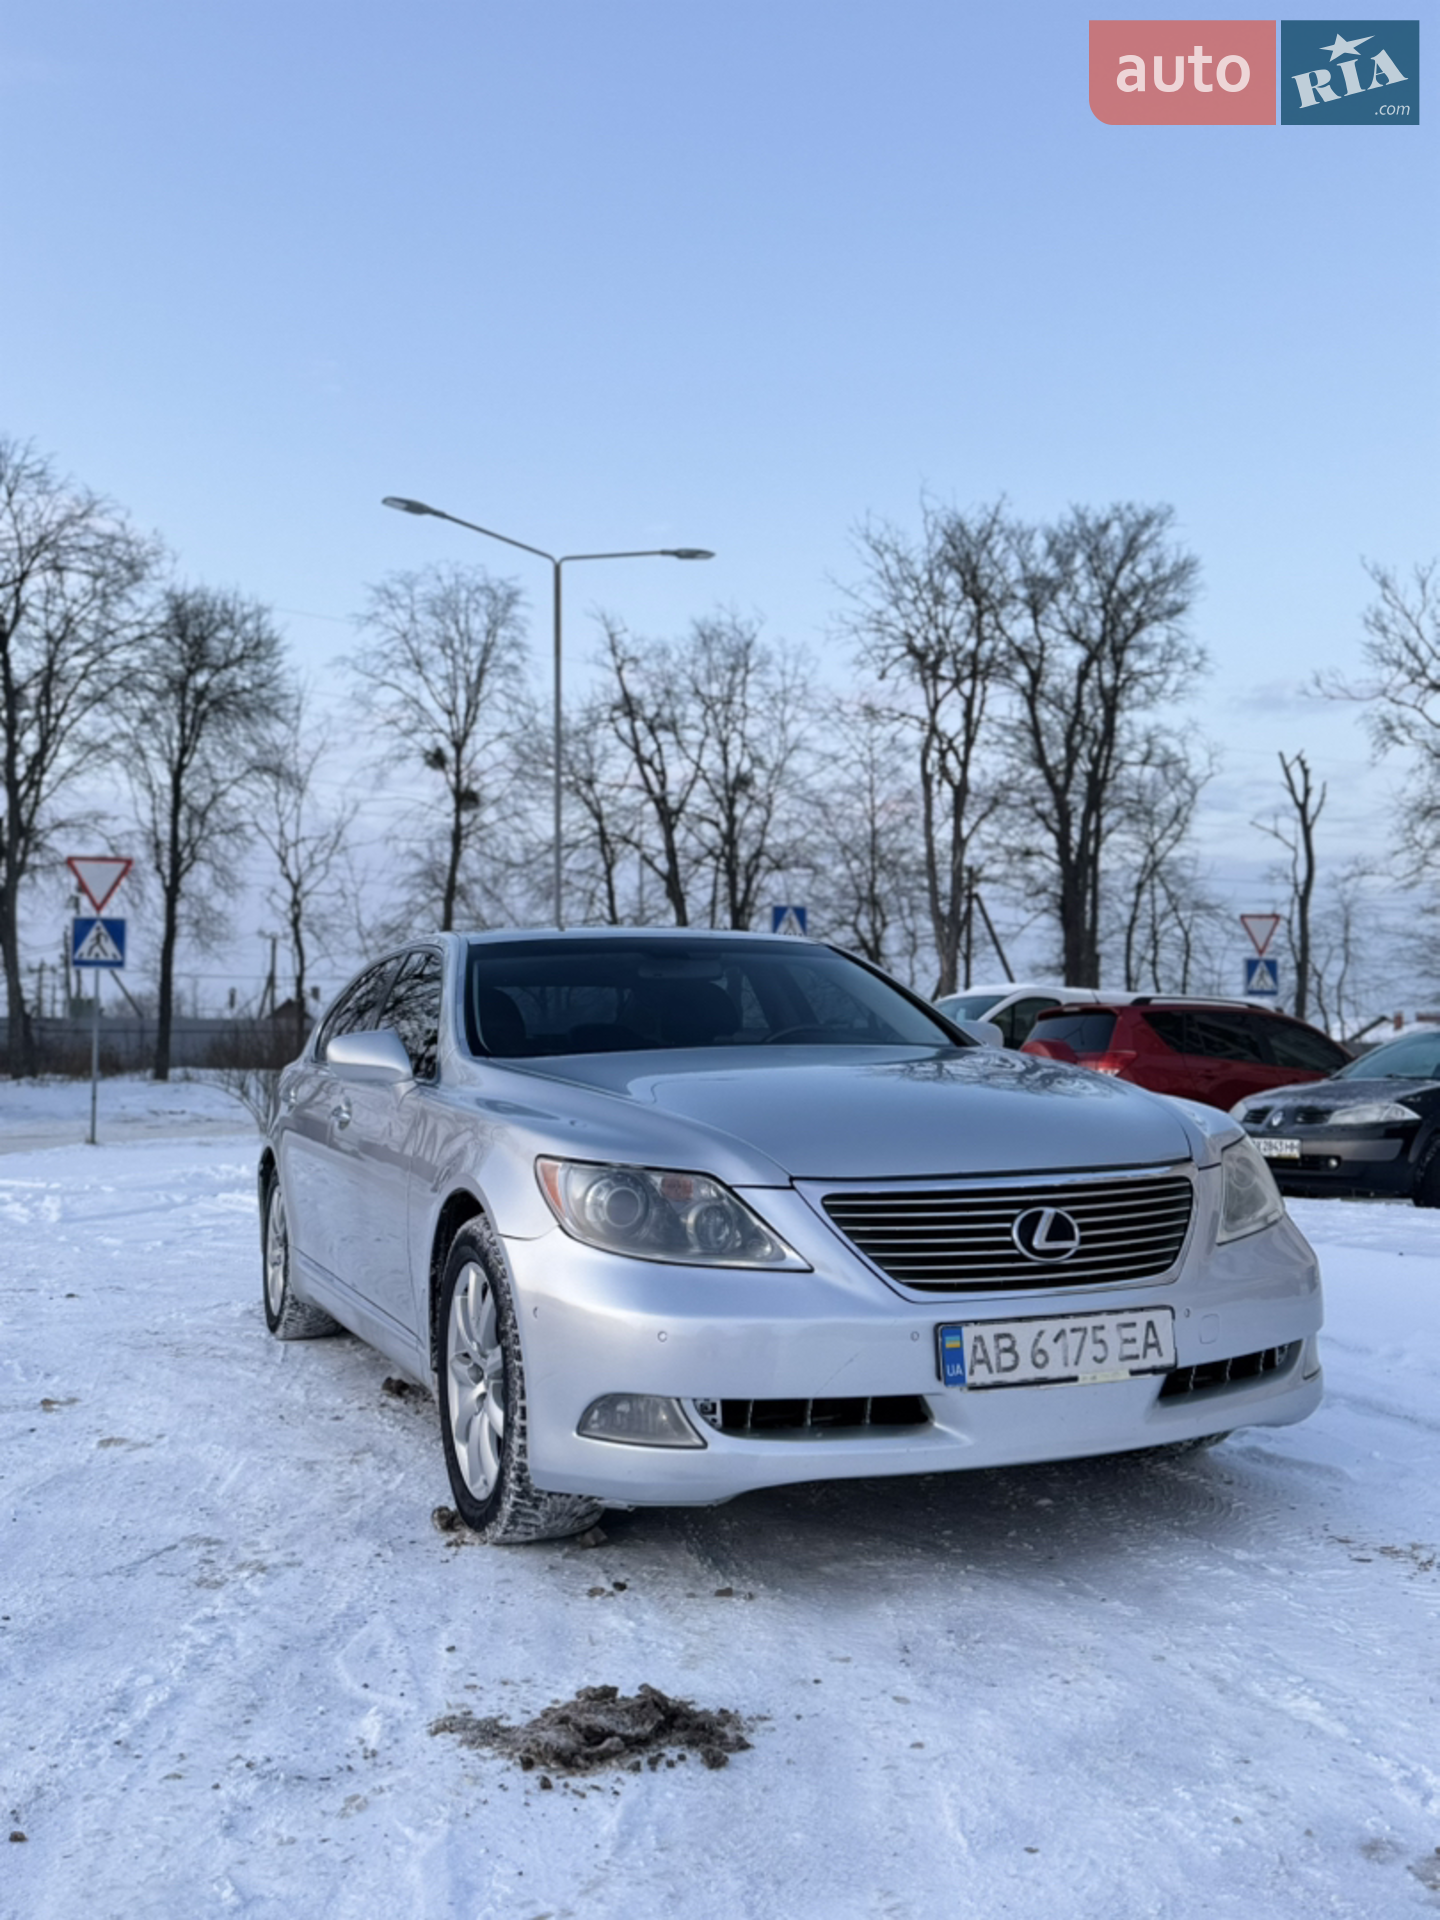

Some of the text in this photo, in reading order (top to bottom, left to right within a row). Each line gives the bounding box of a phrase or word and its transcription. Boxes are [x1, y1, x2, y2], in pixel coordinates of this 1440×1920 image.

[968, 1320, 1164, 1377] AB 6175 EA
[946, 1364, 964, 1377] UA
